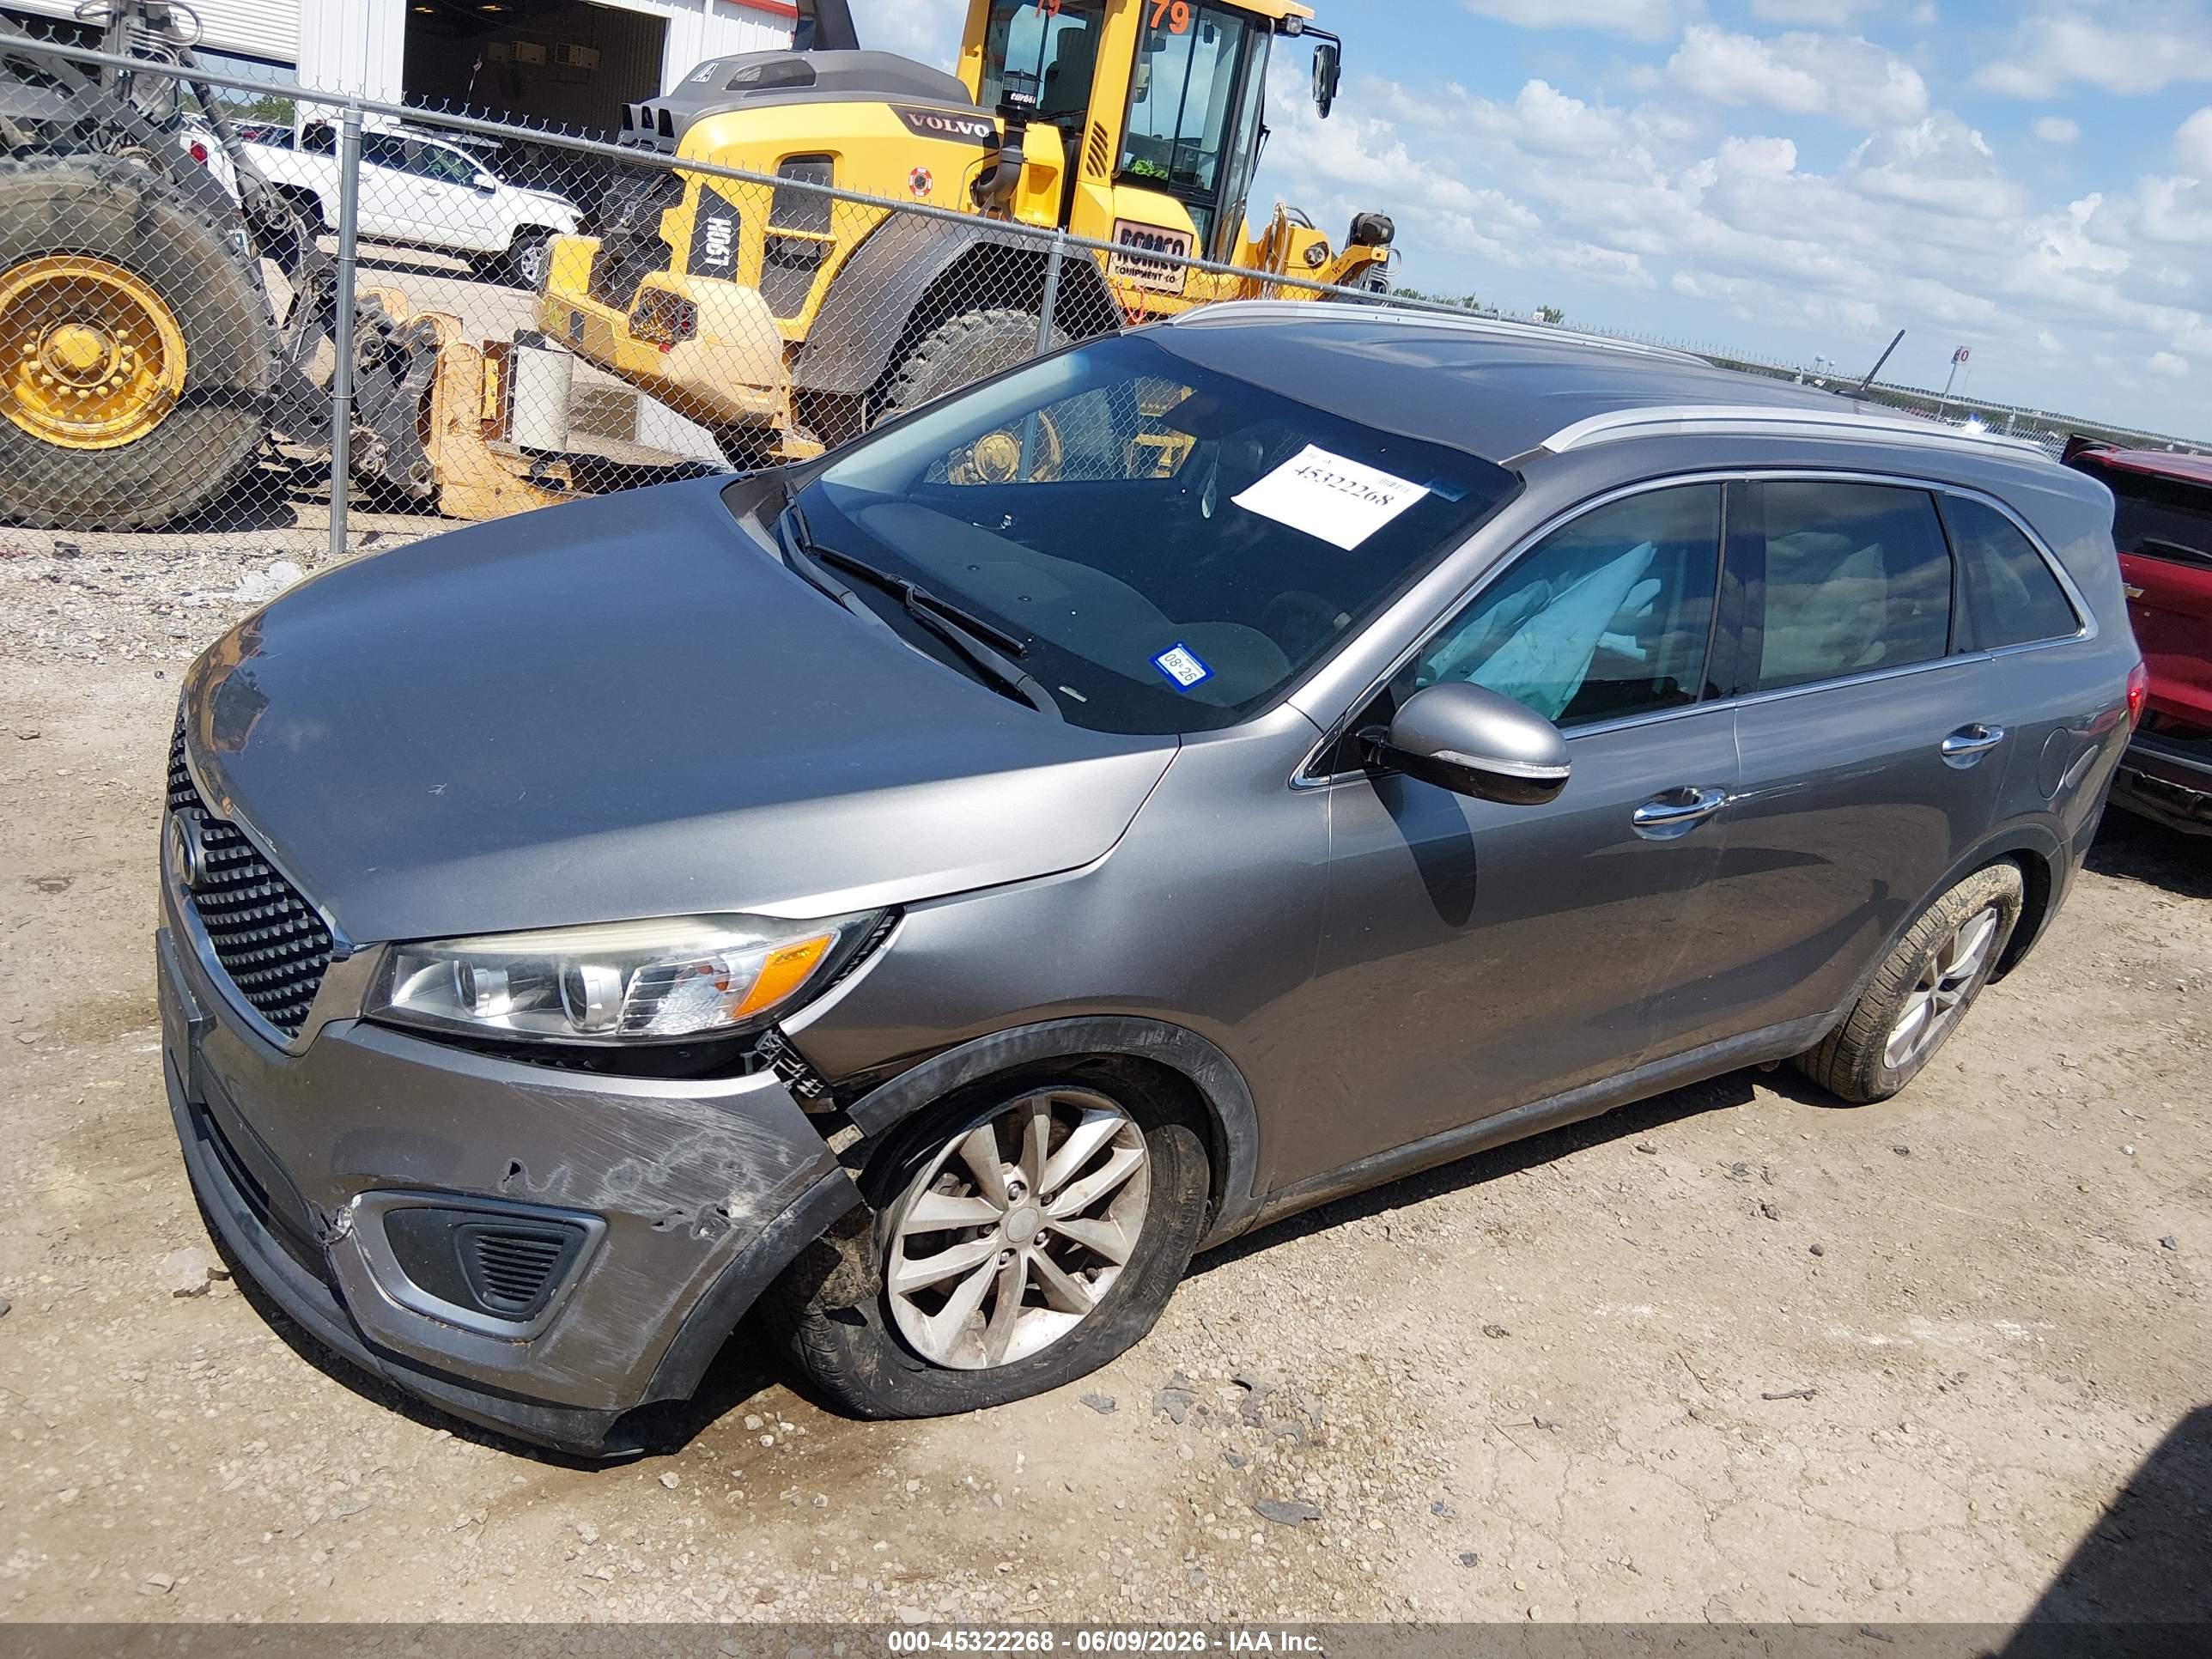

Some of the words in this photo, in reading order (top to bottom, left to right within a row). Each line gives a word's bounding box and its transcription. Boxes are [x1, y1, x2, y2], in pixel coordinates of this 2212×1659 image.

[1150, 0, 1190, 34] 79
[907, 112, 990, 138] VOLVO
[705, 216, 732, 266] L90H
[1115, 265, 1163, 282] EQUIPMENT
[1294, 465, 1395, 507] 45322268
